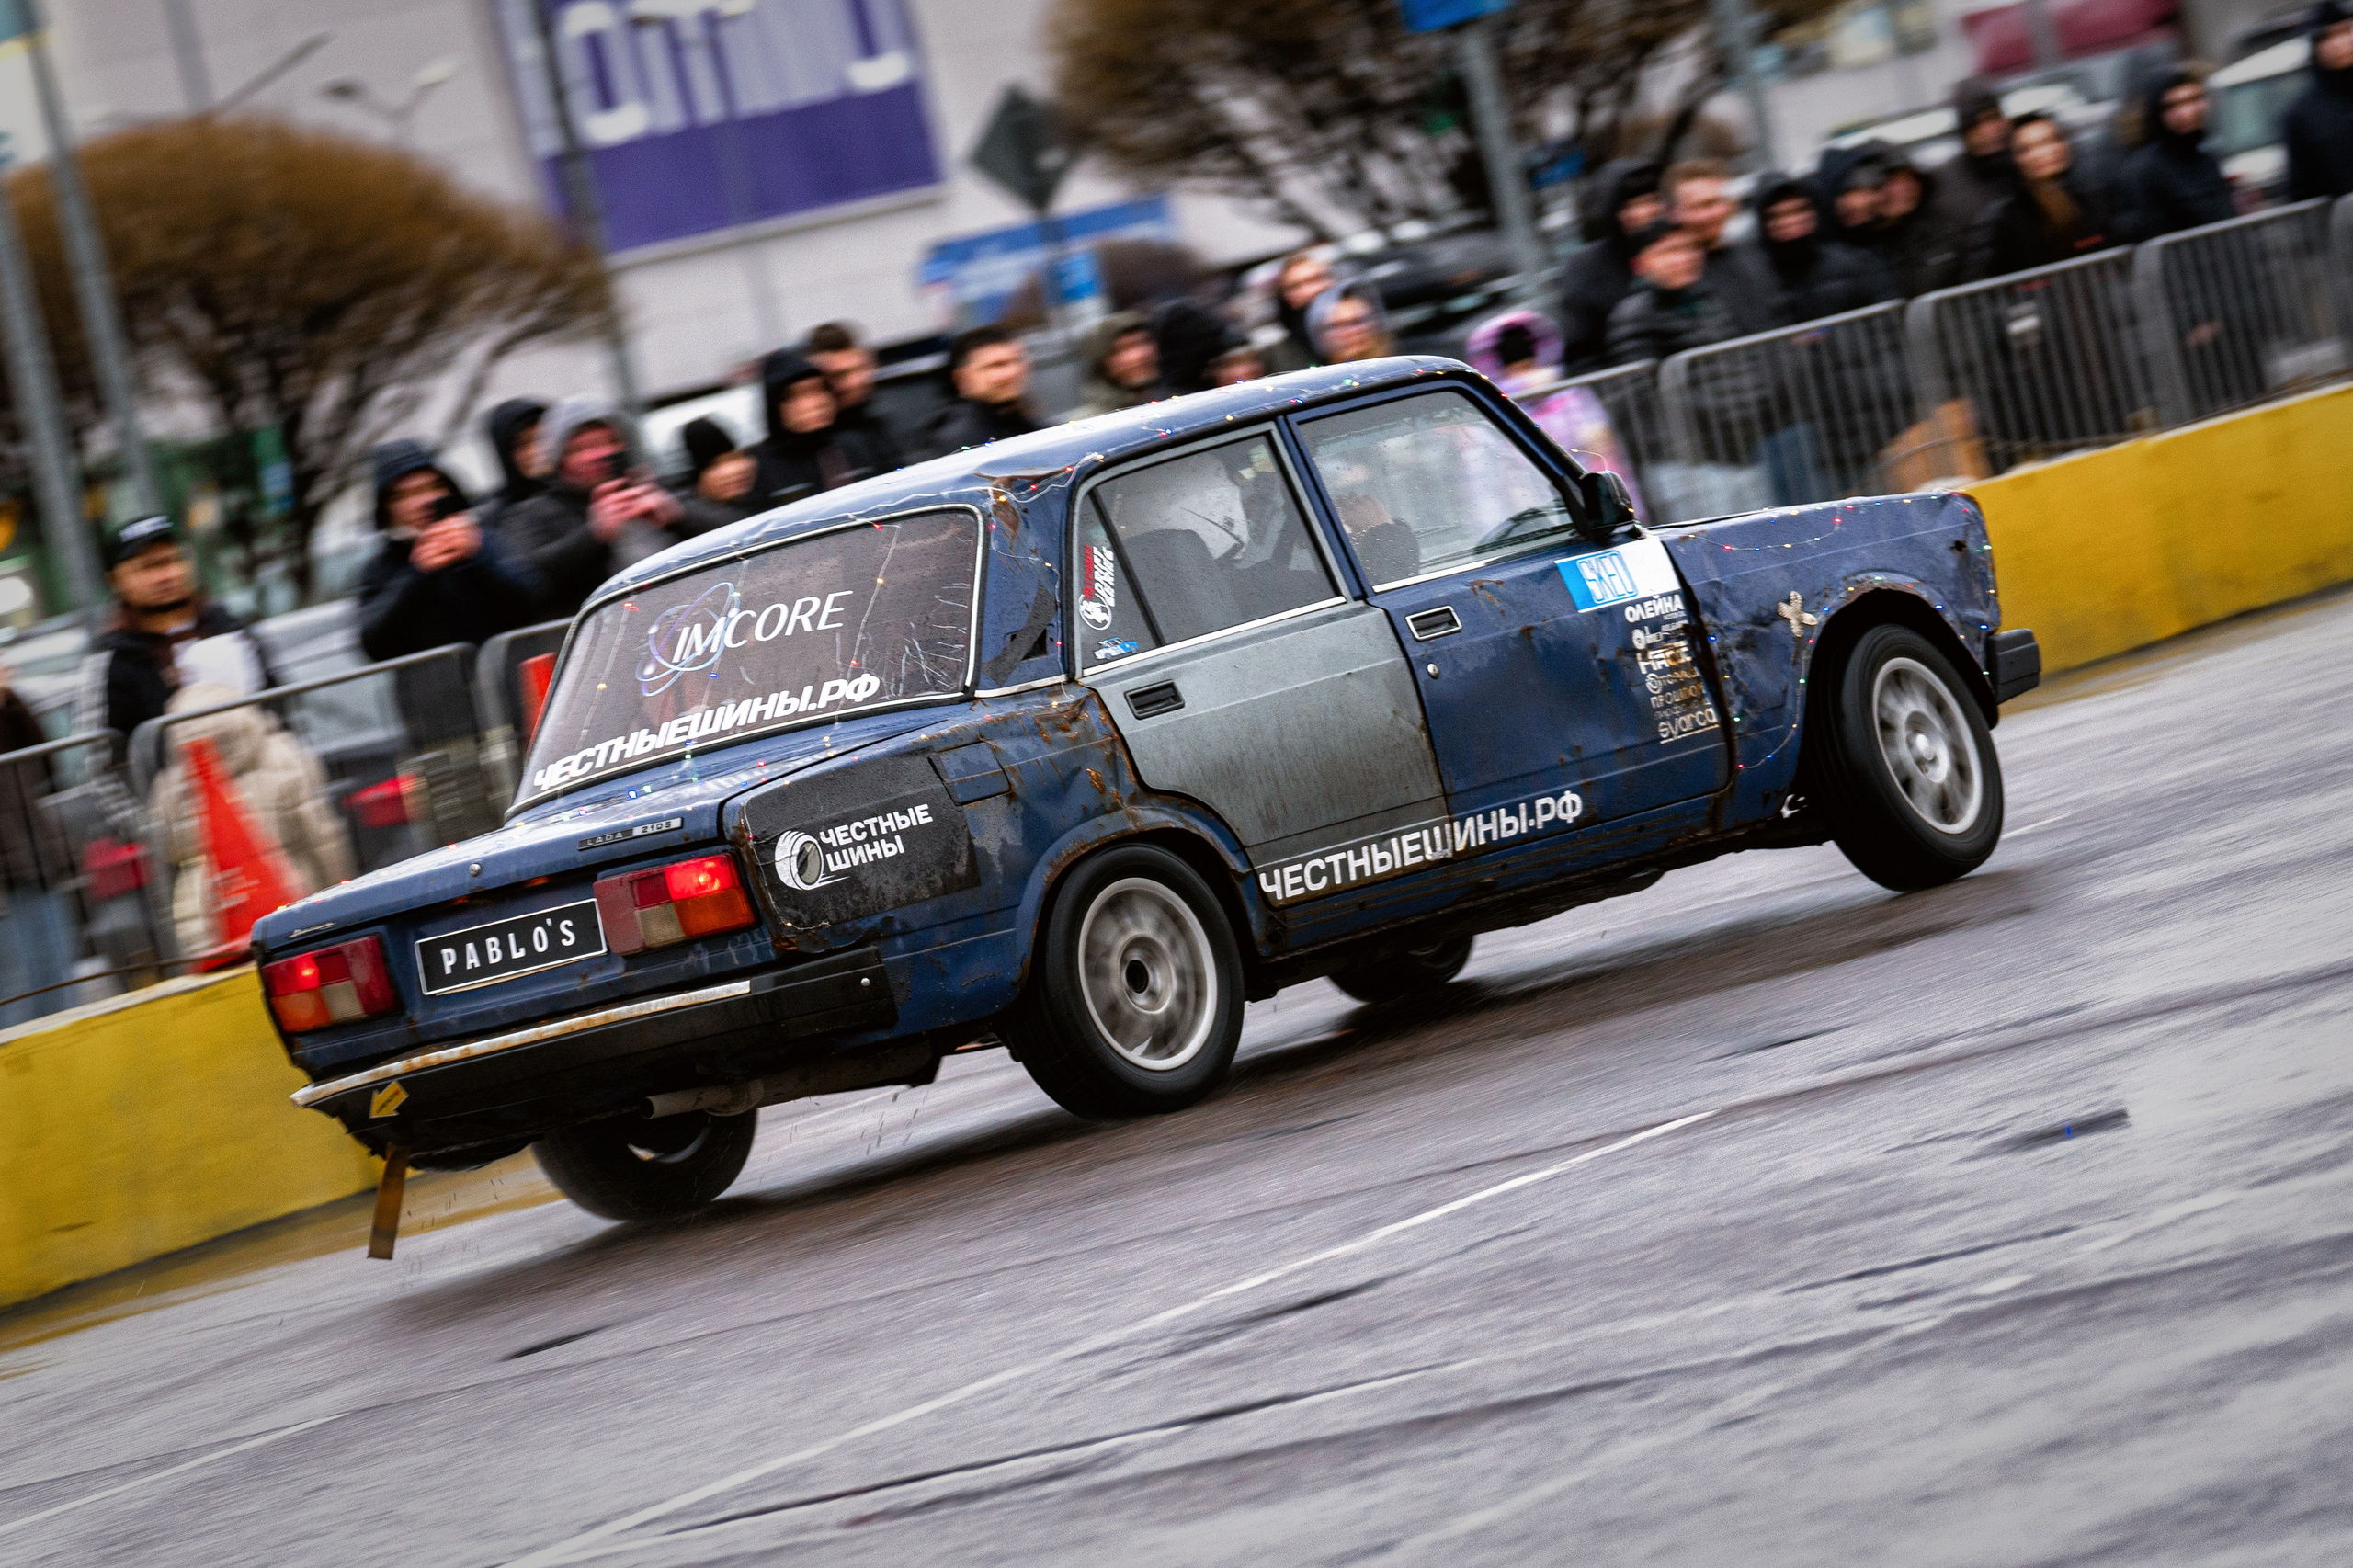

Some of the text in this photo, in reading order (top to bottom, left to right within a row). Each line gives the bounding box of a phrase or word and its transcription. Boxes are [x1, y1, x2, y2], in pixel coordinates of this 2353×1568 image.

[533, 672, 881, 791] ЧЕСТНЫЕШИНЫ.РФ
[586, 821, 672, 846] LADA 2105
[819, 803, 934, 848] ЧЕСТНЫЕ
[1258, 790, 1584, 901] ЧЕСТНЫЕШИНЫ.РФ
[825, 835, 905, 872] ШИНЫ
[440, 917, 576, 975] PABLO'S
